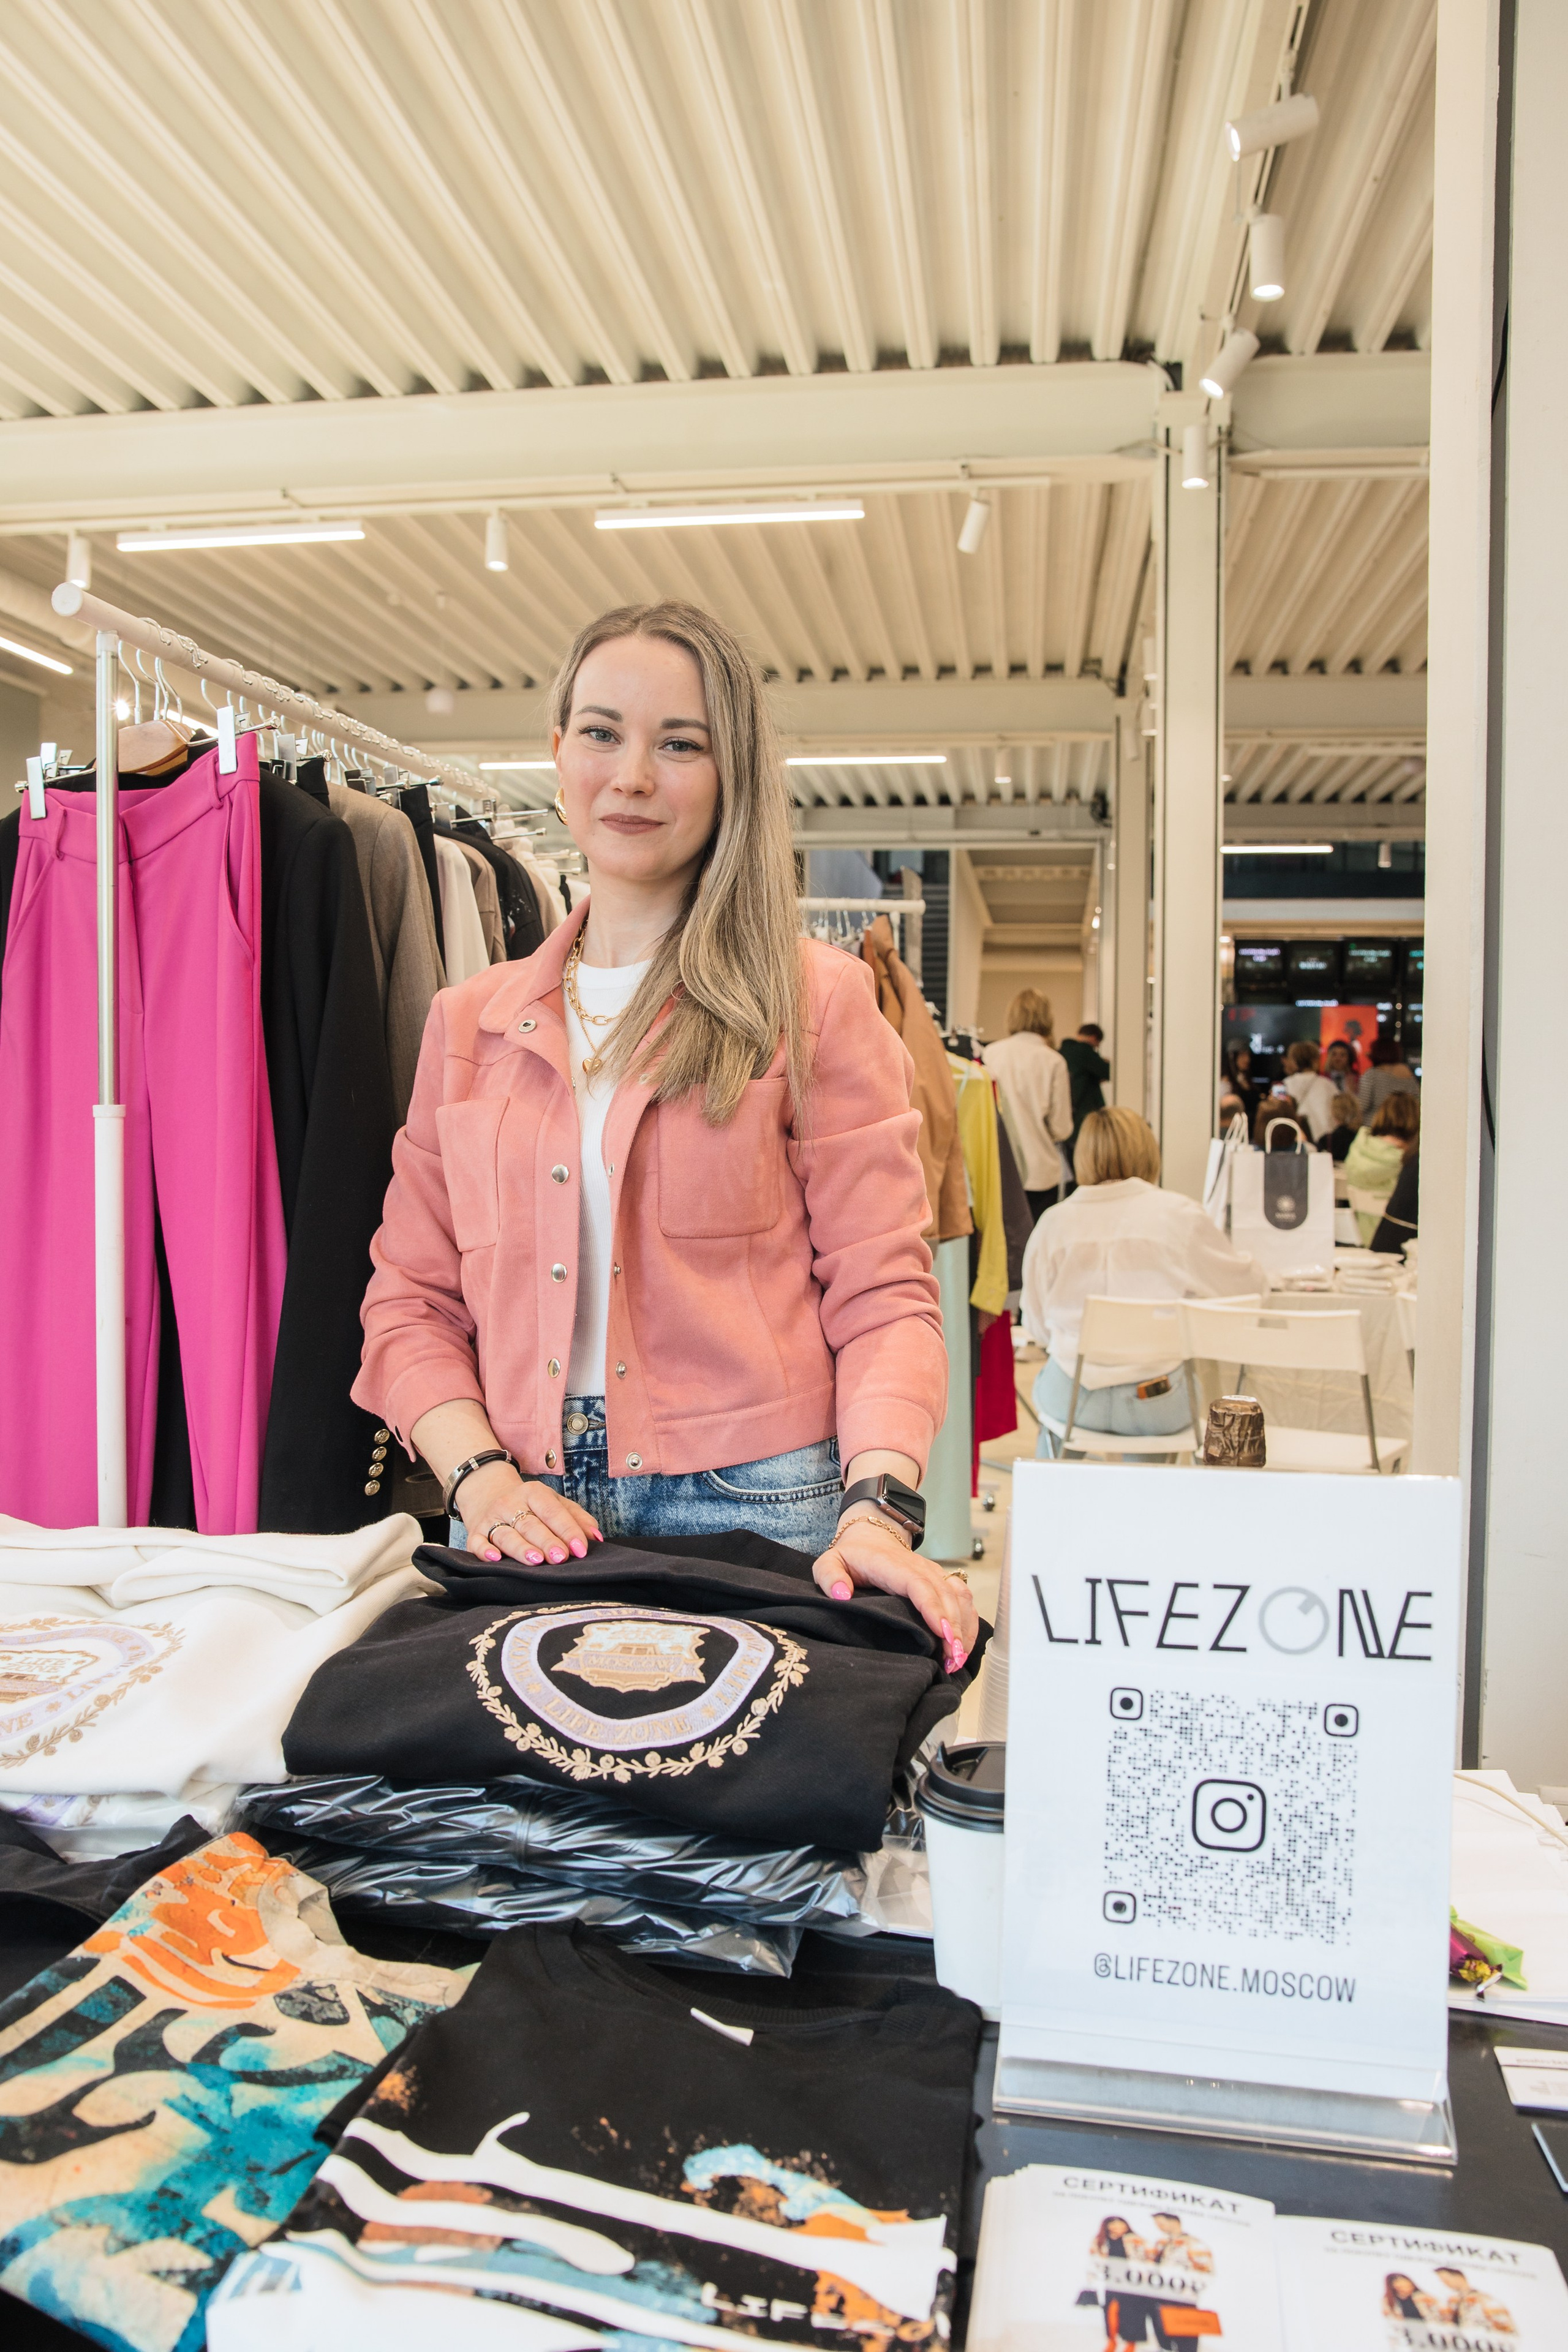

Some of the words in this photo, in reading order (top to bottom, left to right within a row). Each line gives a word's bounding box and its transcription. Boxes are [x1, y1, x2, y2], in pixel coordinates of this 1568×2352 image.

[1031, 1575, 1433, 1661] LIFEZONE
[17, 1657, 70, 1665] LIFE
[589, 1656, 671, 1670] MOSCOW
[715, 1654, 761, 1706] LIFE
[543, 1695, 604, 1740] LIFE
[613, 1714, 693, 1743] ZONE
[1094, 1953, 1357, 2003] @LIFEZONE.MOSCOW
[1063, 2176, 1243, 2214] СЕРТИФИКАТ
[1331, 2231, 1521, 2264] СЕРТИФИКАТ
